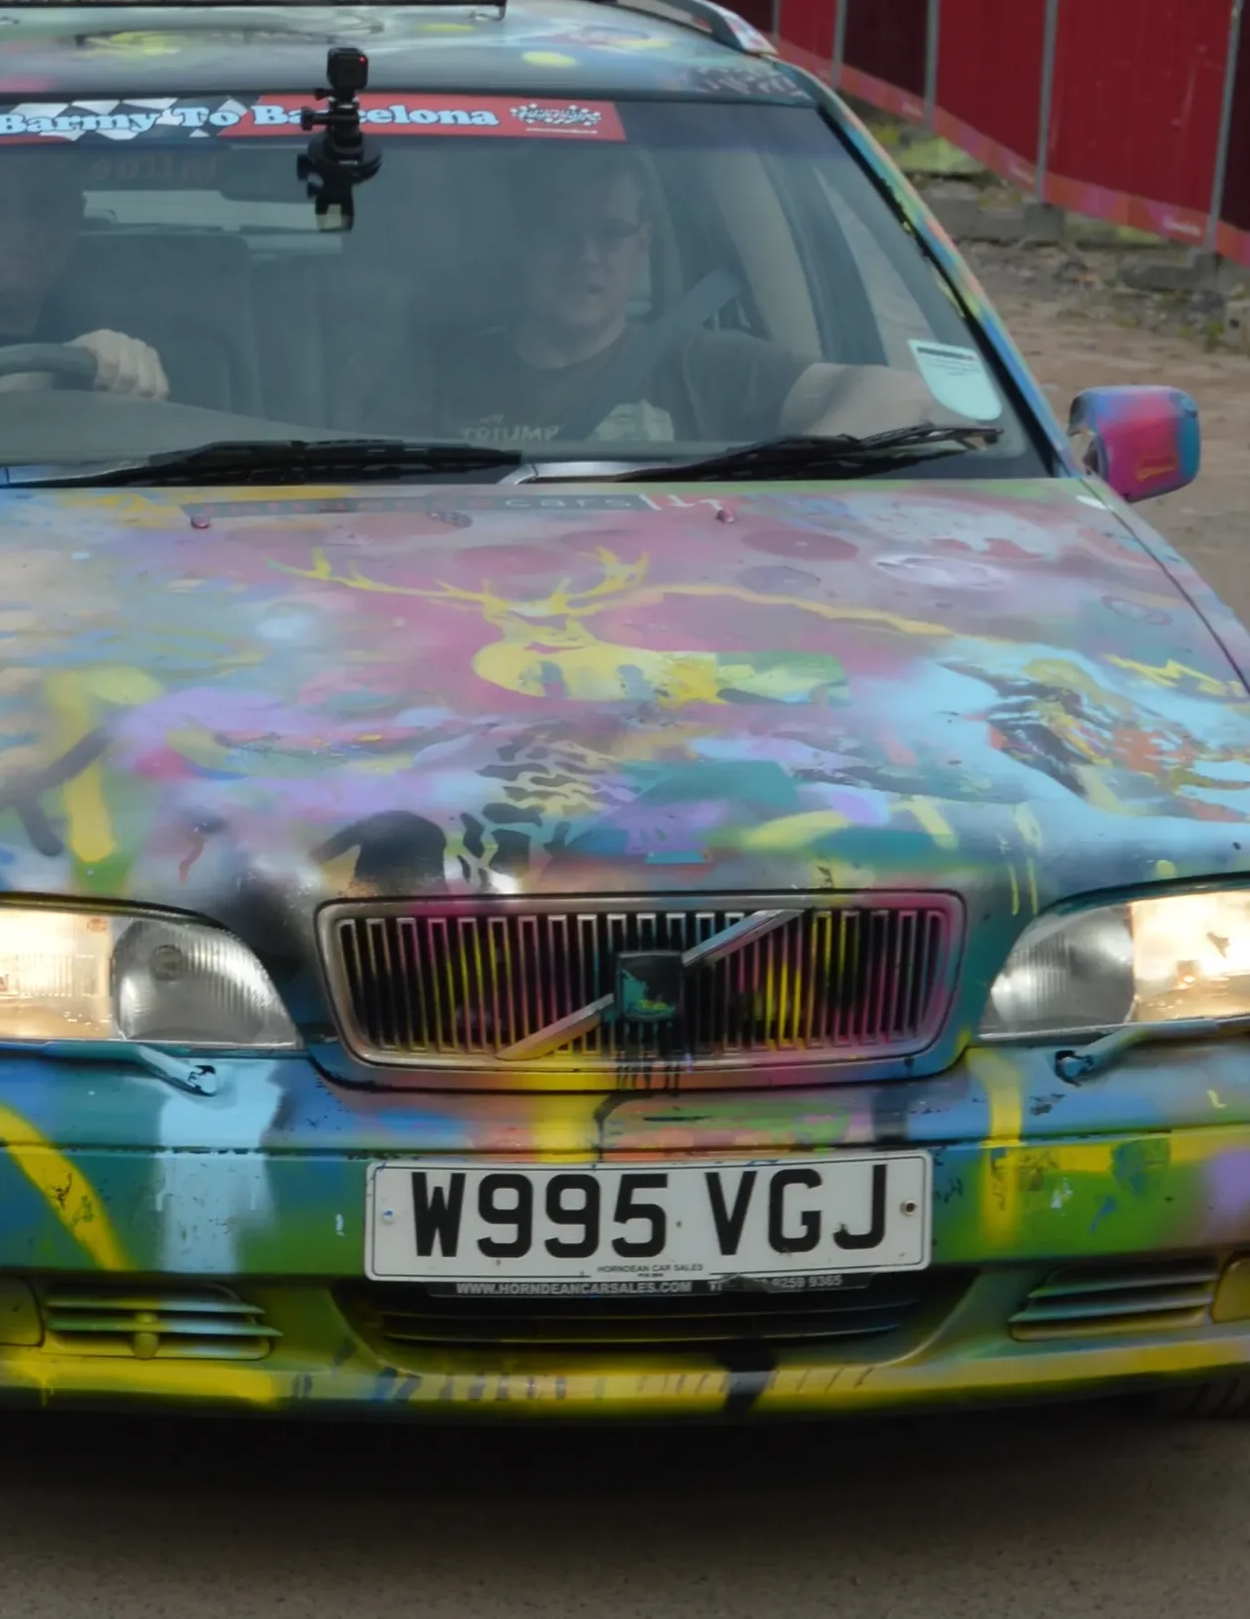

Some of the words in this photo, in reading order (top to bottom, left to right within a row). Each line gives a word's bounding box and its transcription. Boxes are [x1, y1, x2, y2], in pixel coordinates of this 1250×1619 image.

[172, 106, 242, 127] To
[249, 104, 501, 127] Belona
[410, 1171, 669, 1259] W995
[704, 1163, 888, 1257] VGJ
[652, 1264, 671, 1273] CAR
[674, 1263, 704, 1272] SALES
[455, 1280, 693, 1295] WWW.HORNDEANCARSALES.COM
